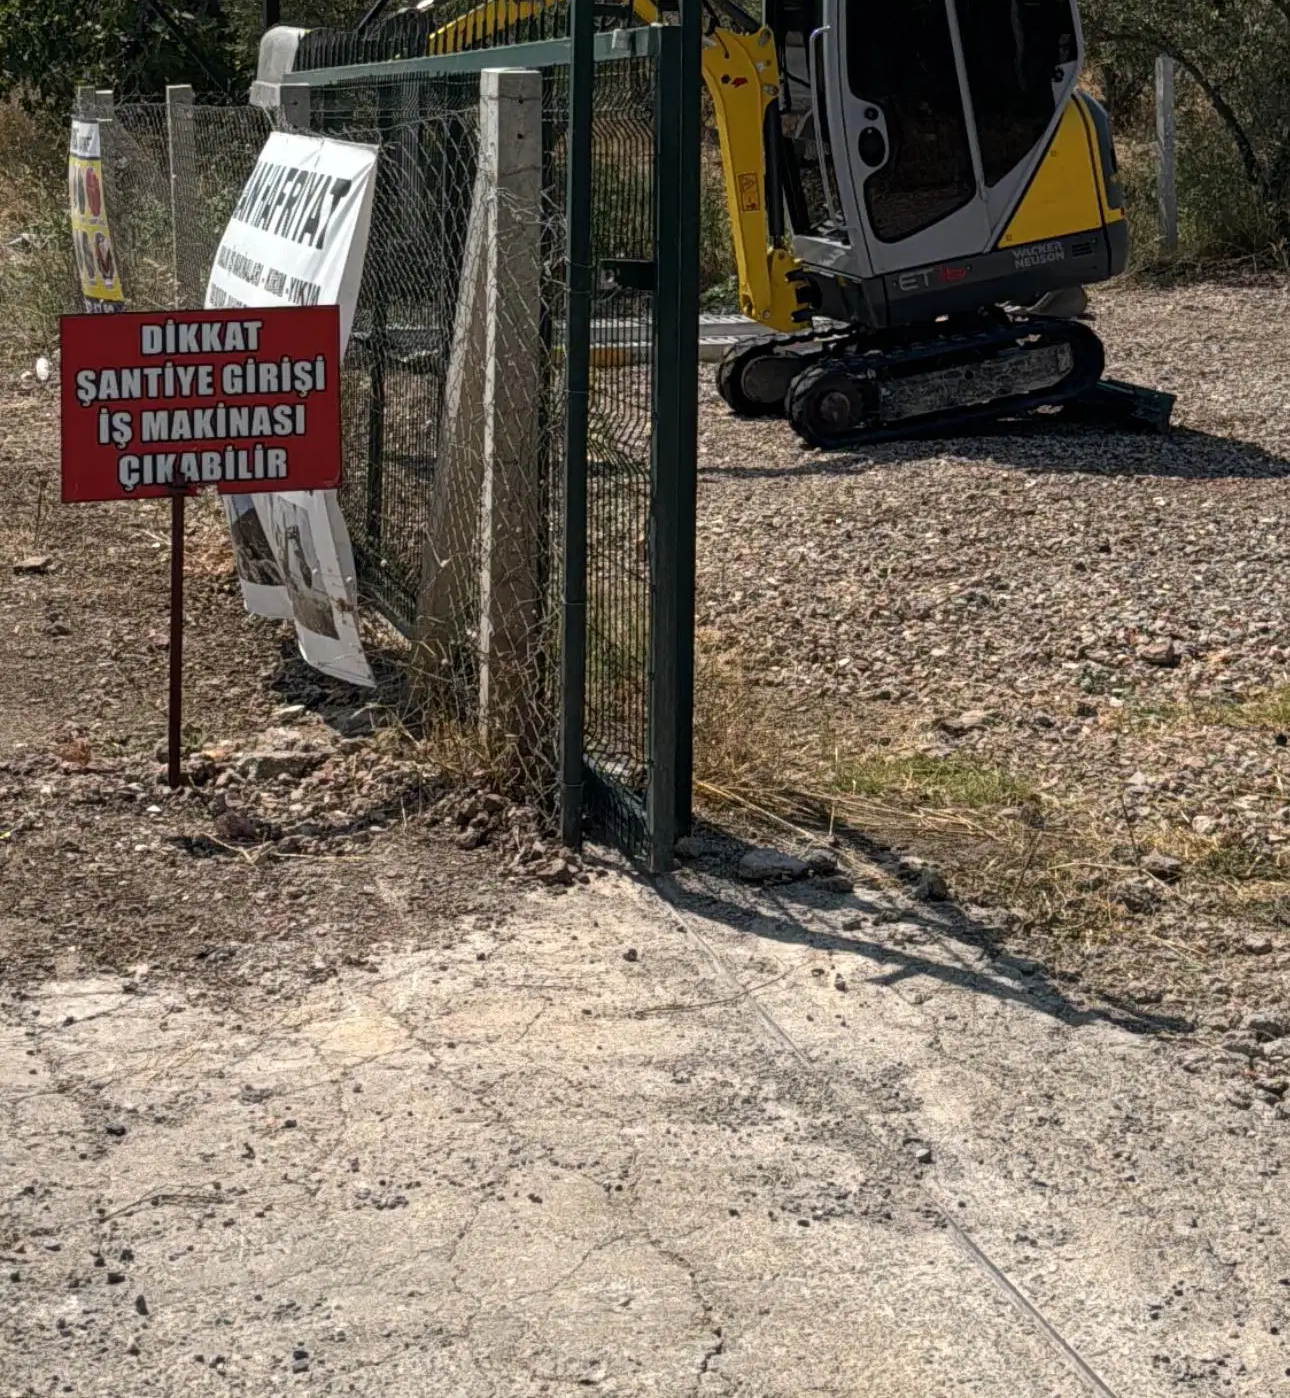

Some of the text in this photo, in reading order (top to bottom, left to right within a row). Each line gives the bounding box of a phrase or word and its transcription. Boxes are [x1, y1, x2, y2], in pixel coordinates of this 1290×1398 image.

[141, 319, 263, 355] DİKKAT
[76, 355, 326, 408] ŞANTİYE GİRİŞİ
[98, 402, 306, 449] İŞ MAKİNASI
[117, 443, 289, 492] ÇIKABİLİR
